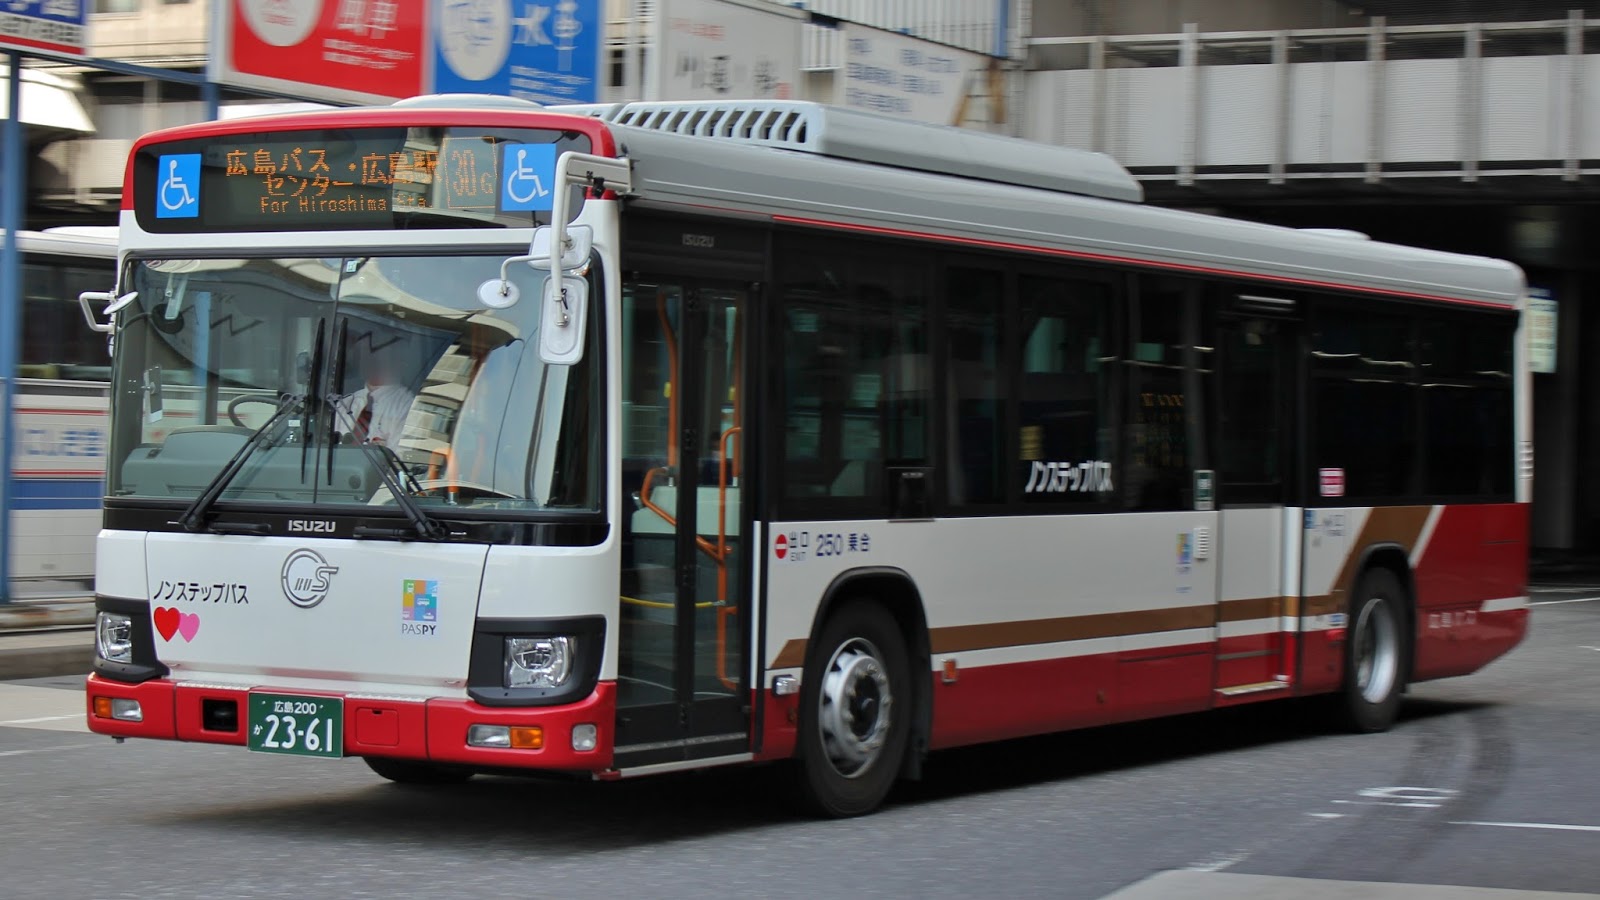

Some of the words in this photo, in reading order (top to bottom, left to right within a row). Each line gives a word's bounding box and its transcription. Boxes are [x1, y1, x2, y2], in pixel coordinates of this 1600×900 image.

[262, 173, 354, 197] センター
[260, 196, 289, 214] For
[299, 194, 387, 213] Hiroshima
[682, 233, 715, 248] ISUZU
[1024, 460, 1114, 493] ノンステップバス
[288, 519, 337, 533] ISUZU
[789, 531, 808, 549] 出口
[816, 533, 843, 557] 250
[848, 532, 870, 552] 乗合
[153, 580, 249, 604] ノンステップバス
[401, 623, 437, 636] PASPY
[253, 724, 263, 736] か
[264, 714, 333, 752] 23-61
